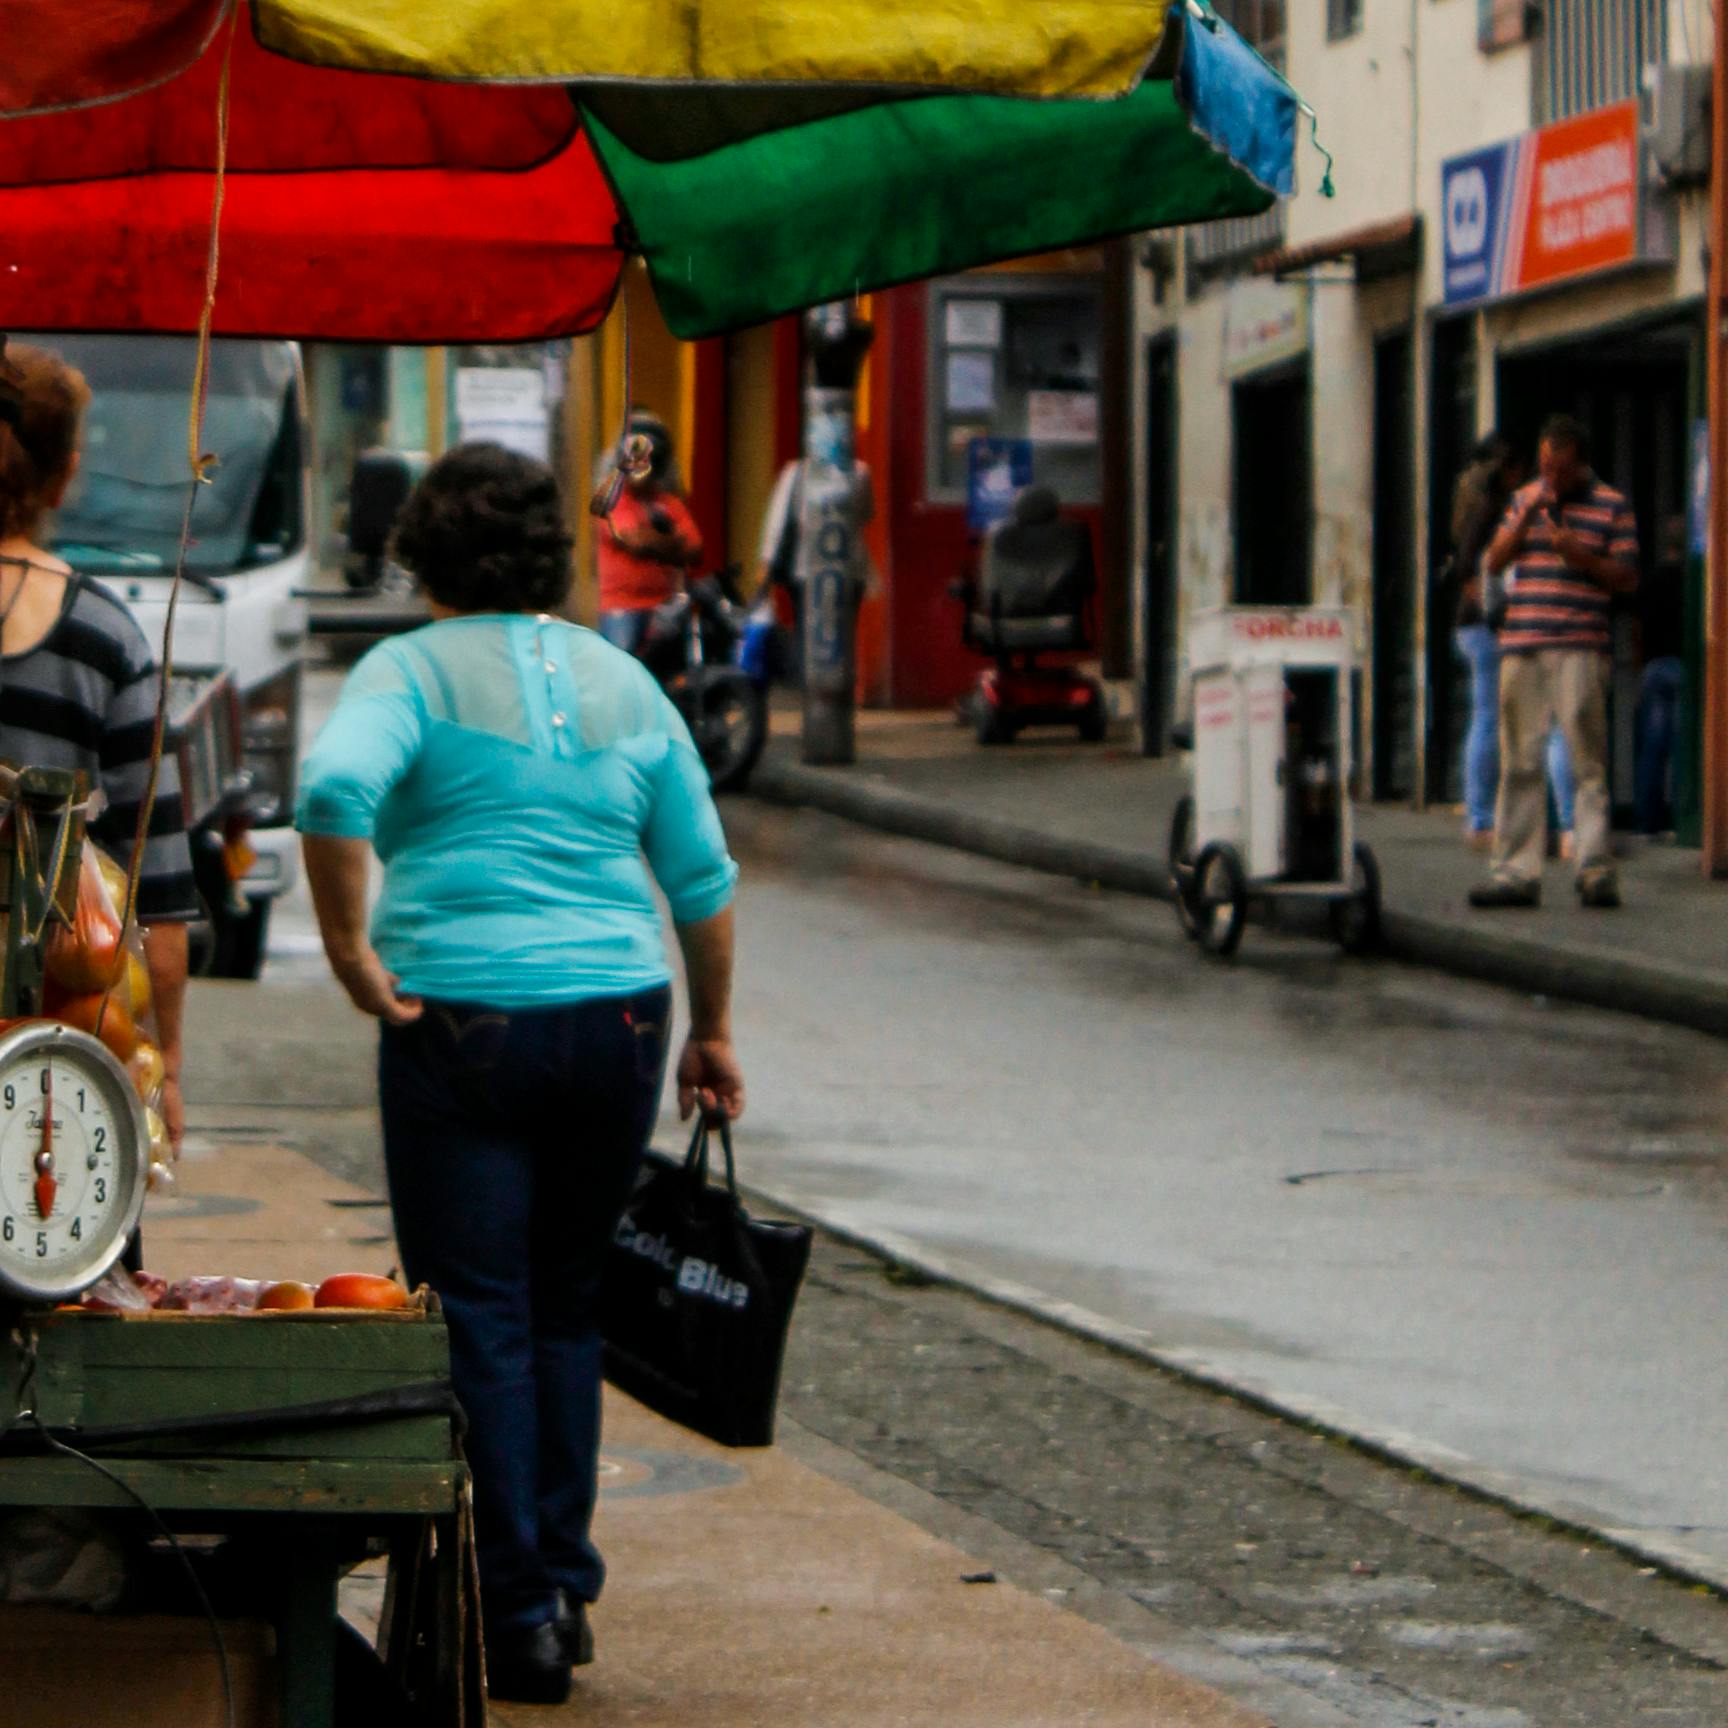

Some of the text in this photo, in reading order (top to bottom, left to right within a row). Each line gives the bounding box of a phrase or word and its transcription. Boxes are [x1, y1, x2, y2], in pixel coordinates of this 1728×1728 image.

[4, 1085, 15, 1110] 9
[77, 1088, 85, 1112] 1
[94, 1126, 106, 1152] 2
[94, 1177, 106, 1203] 3
[3, 1216, 14, 1241] 6
[70, 1216, 81, 1241] 4
[36, 1232, 47, 1257] 5
